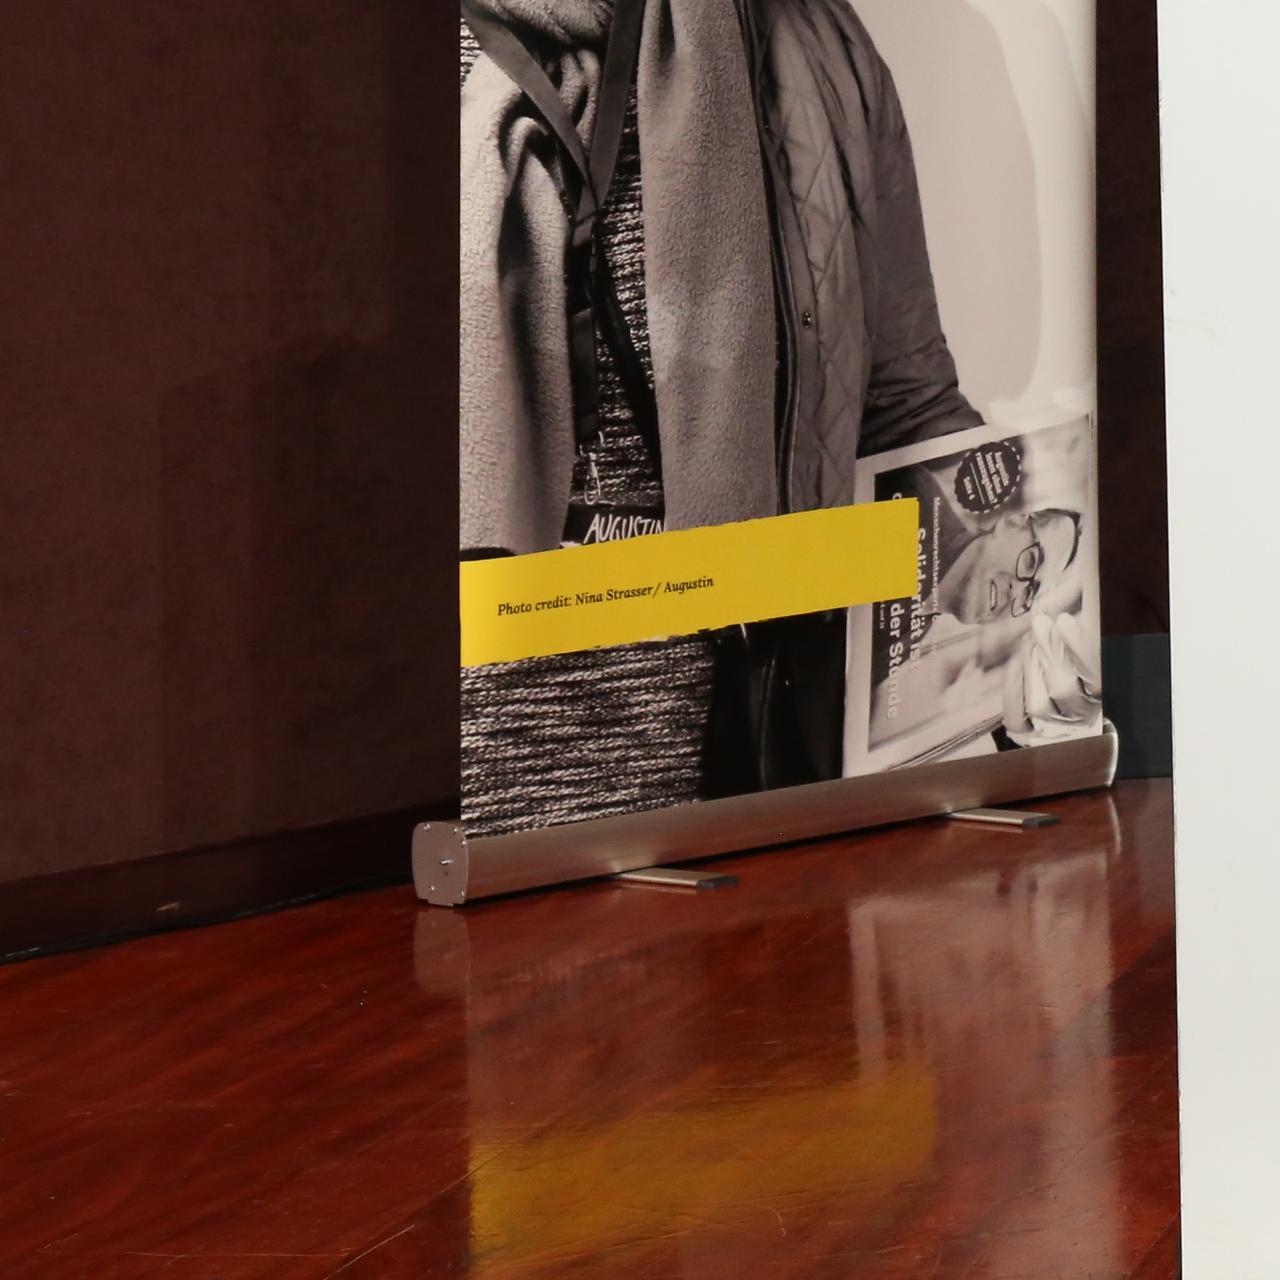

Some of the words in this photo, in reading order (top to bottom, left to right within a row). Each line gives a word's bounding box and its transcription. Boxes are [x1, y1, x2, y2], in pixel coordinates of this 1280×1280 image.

[498, 602, 532, 616] Photo
[535, 596, 572, 610] credit:
[575, 591, 604, 606] Nina
[664, 576, 714, 595] Augustin
[889, 603, 905, 638] der
[887, 642, 904, 721] Stunde
